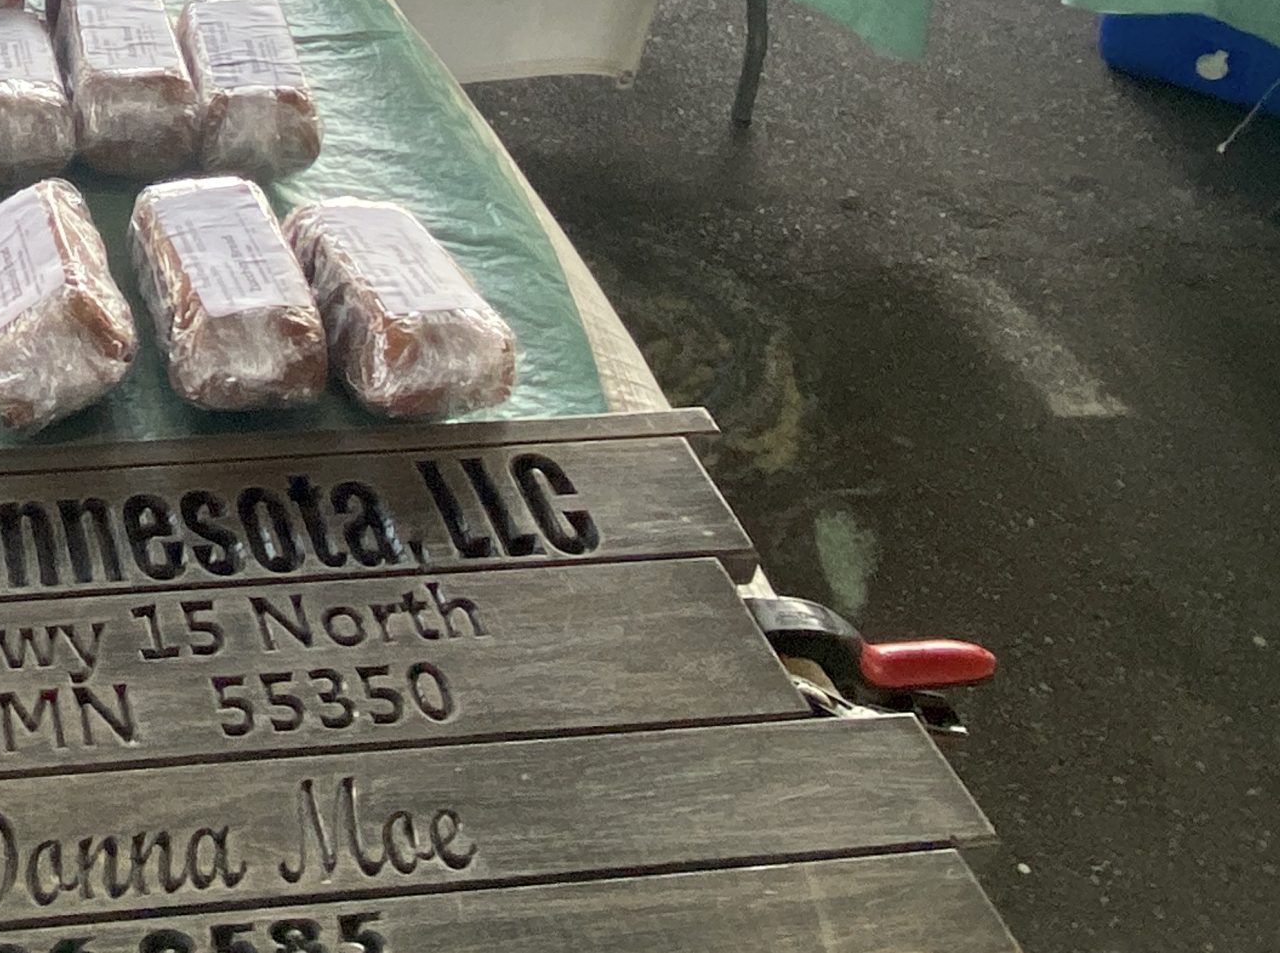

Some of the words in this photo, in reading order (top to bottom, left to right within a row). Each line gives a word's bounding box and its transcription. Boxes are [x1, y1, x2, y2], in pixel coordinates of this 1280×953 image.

[417, 452, 602, 560] LLC
[131, 600, 223, 660] 15
[248, 581, 489, 651] North
[214, 660, 458, 737] 55350
